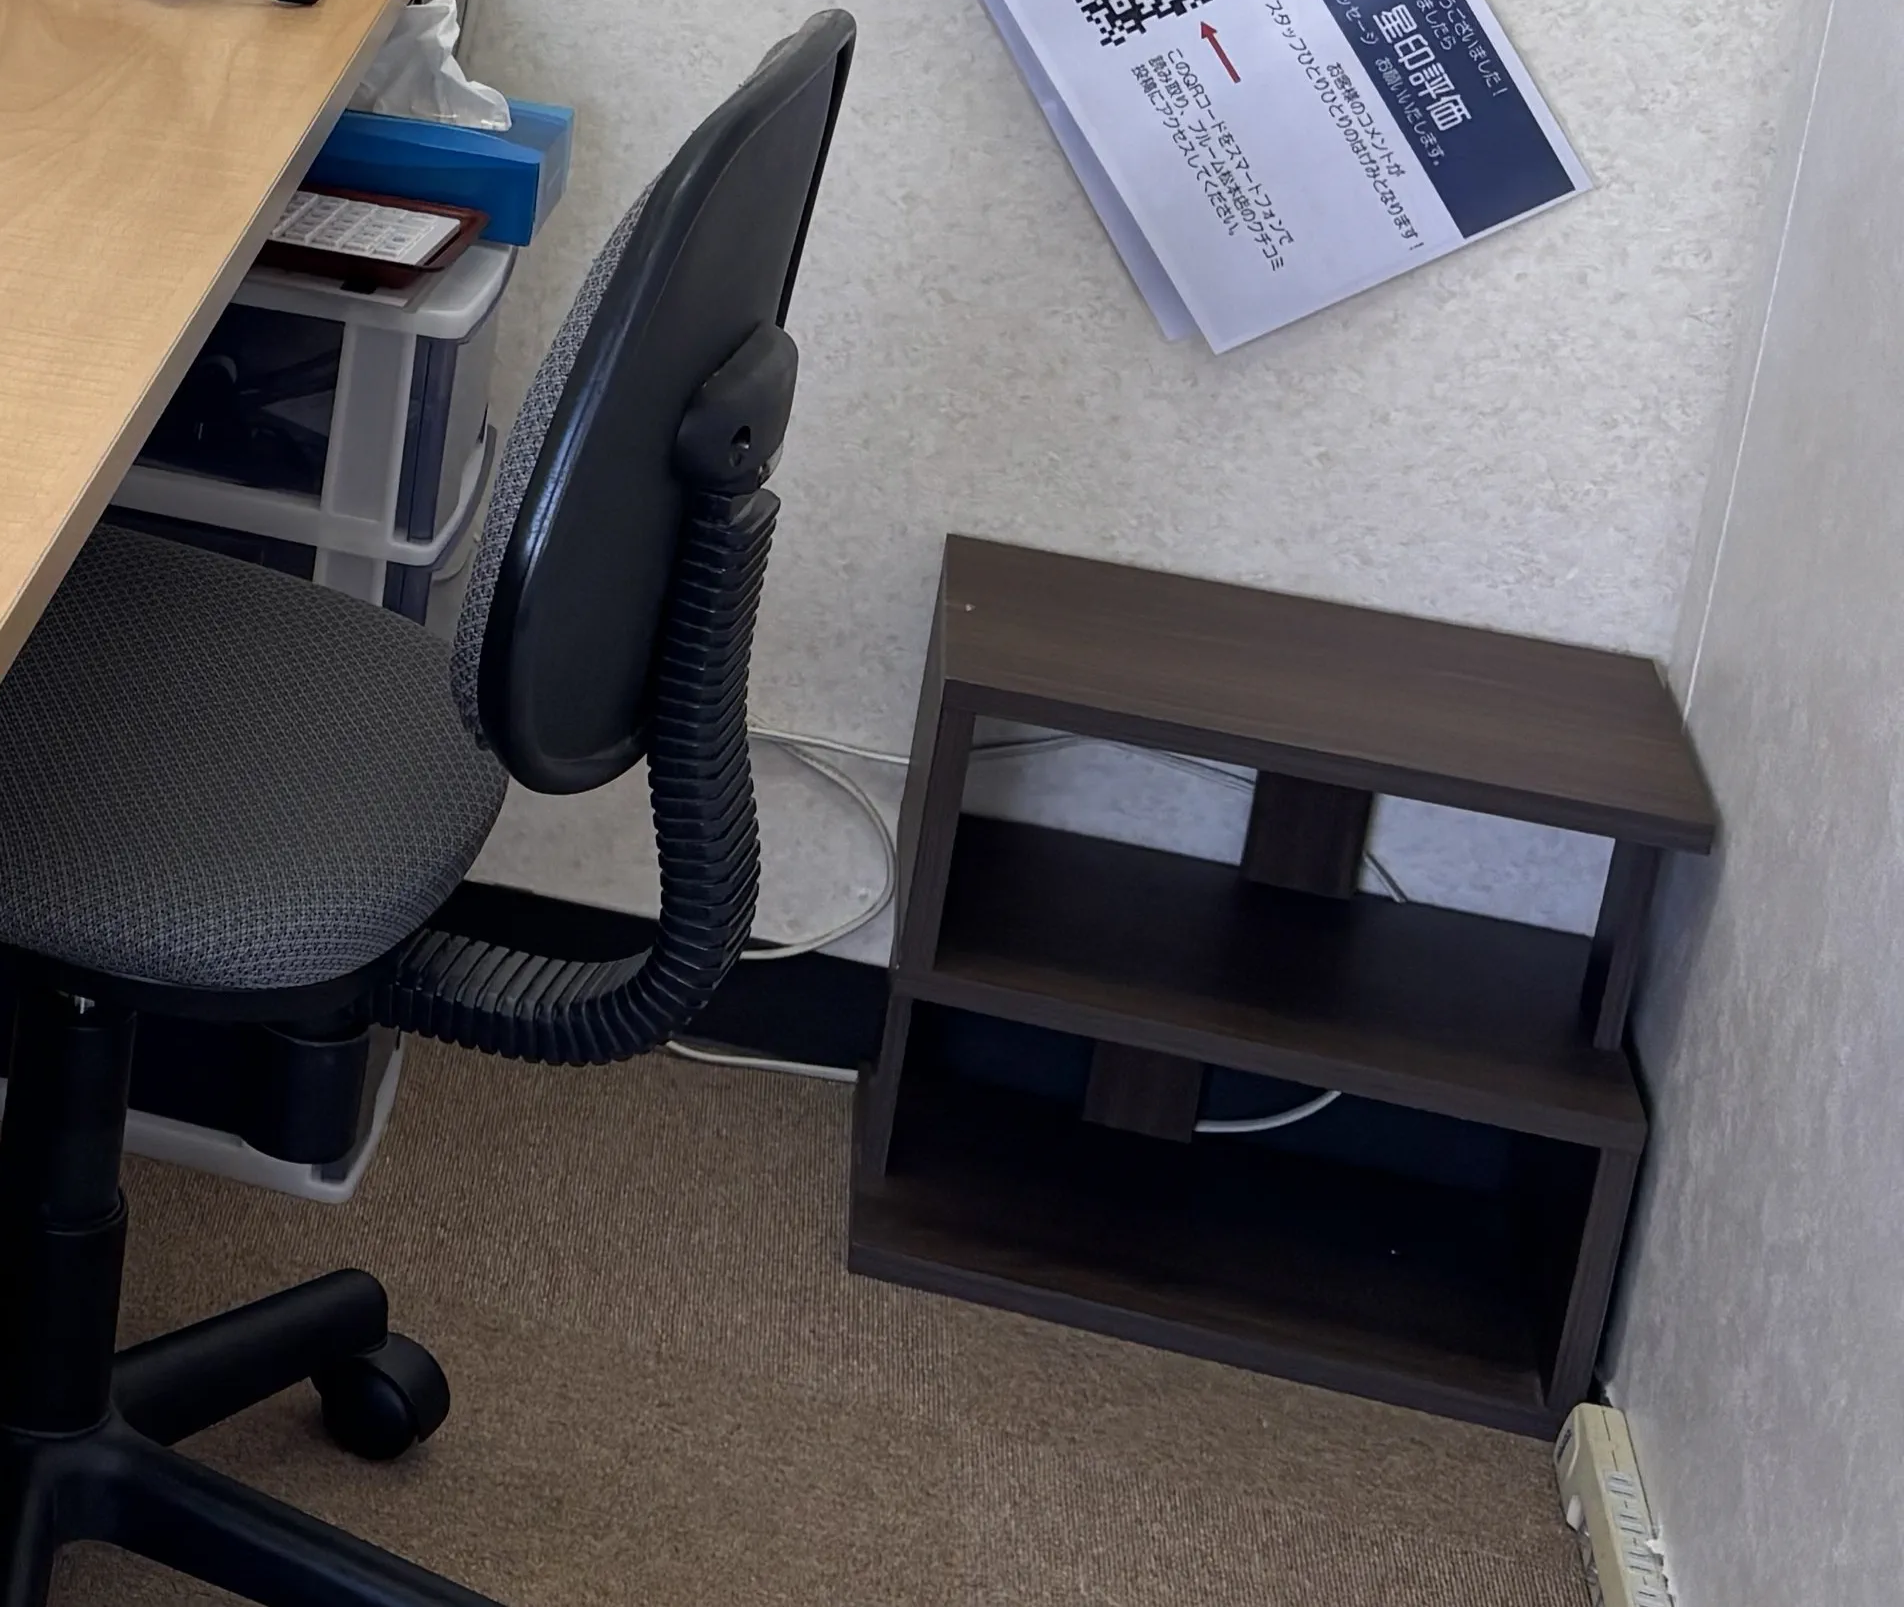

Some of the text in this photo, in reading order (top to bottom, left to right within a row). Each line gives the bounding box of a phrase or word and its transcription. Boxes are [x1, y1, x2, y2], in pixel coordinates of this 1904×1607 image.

[1328, 60, 1407, 178] お客様のコメントが
[1373, 0, 1472, 133] 星印評価
[1374, 54, 1445, 167] お願いいたします。
[1131, 63, 1238, 239] 投稿にアクセスしてください。
[1150, 53, 1286, 273] 読み取り、ブルーム松本店のクチコミ
[1166, 46, 1297, 247] このQRコードをスマートフォンで
